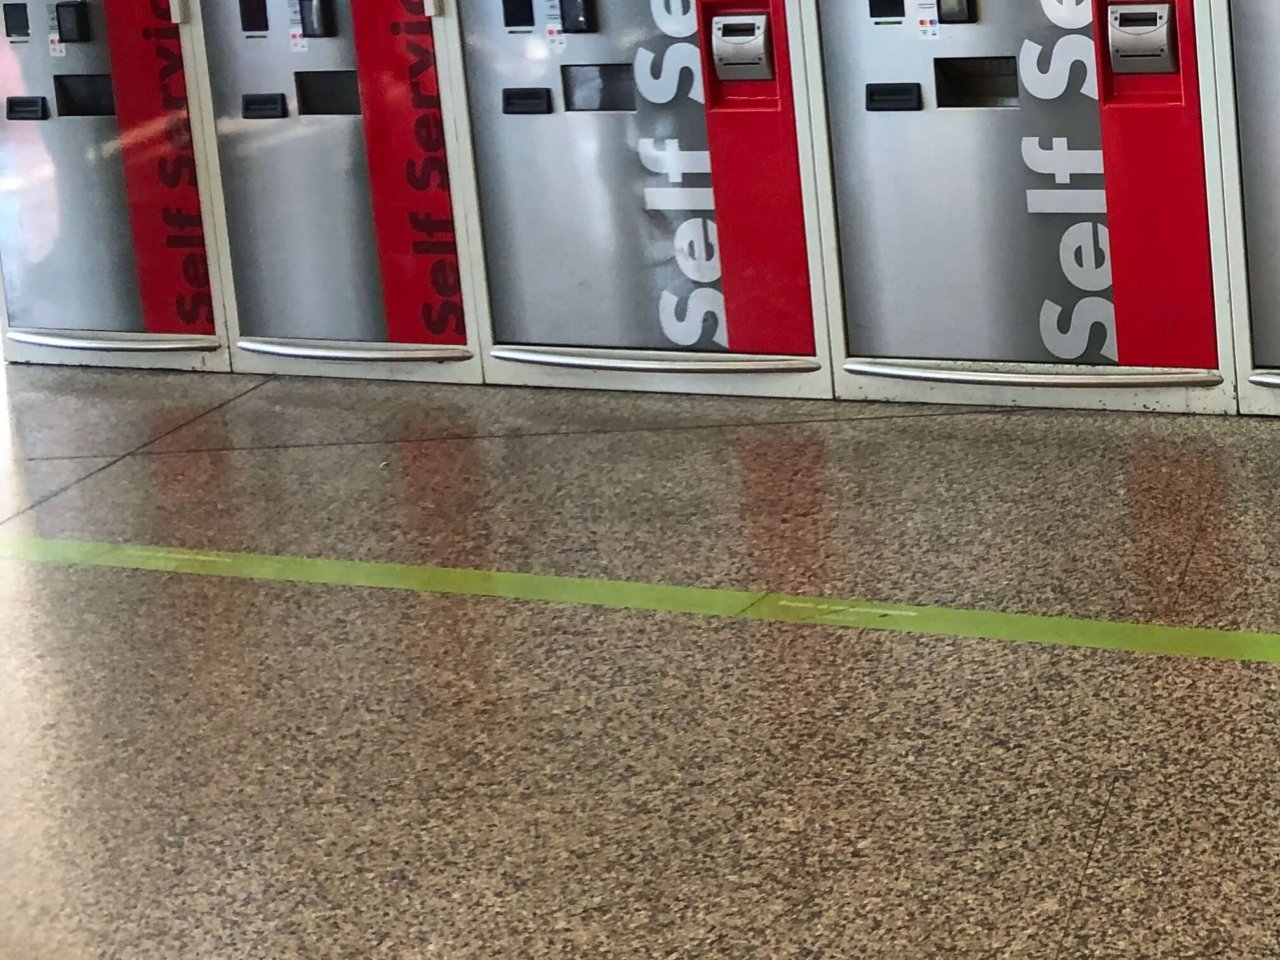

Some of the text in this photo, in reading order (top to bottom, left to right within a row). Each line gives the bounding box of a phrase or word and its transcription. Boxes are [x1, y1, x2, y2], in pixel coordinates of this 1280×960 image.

[162, 206, 215, 324] Self
[408, 212, 466, 335] Self
[638, 138, 730, 349] Self
[1021, 136, 1119, 362] Self
